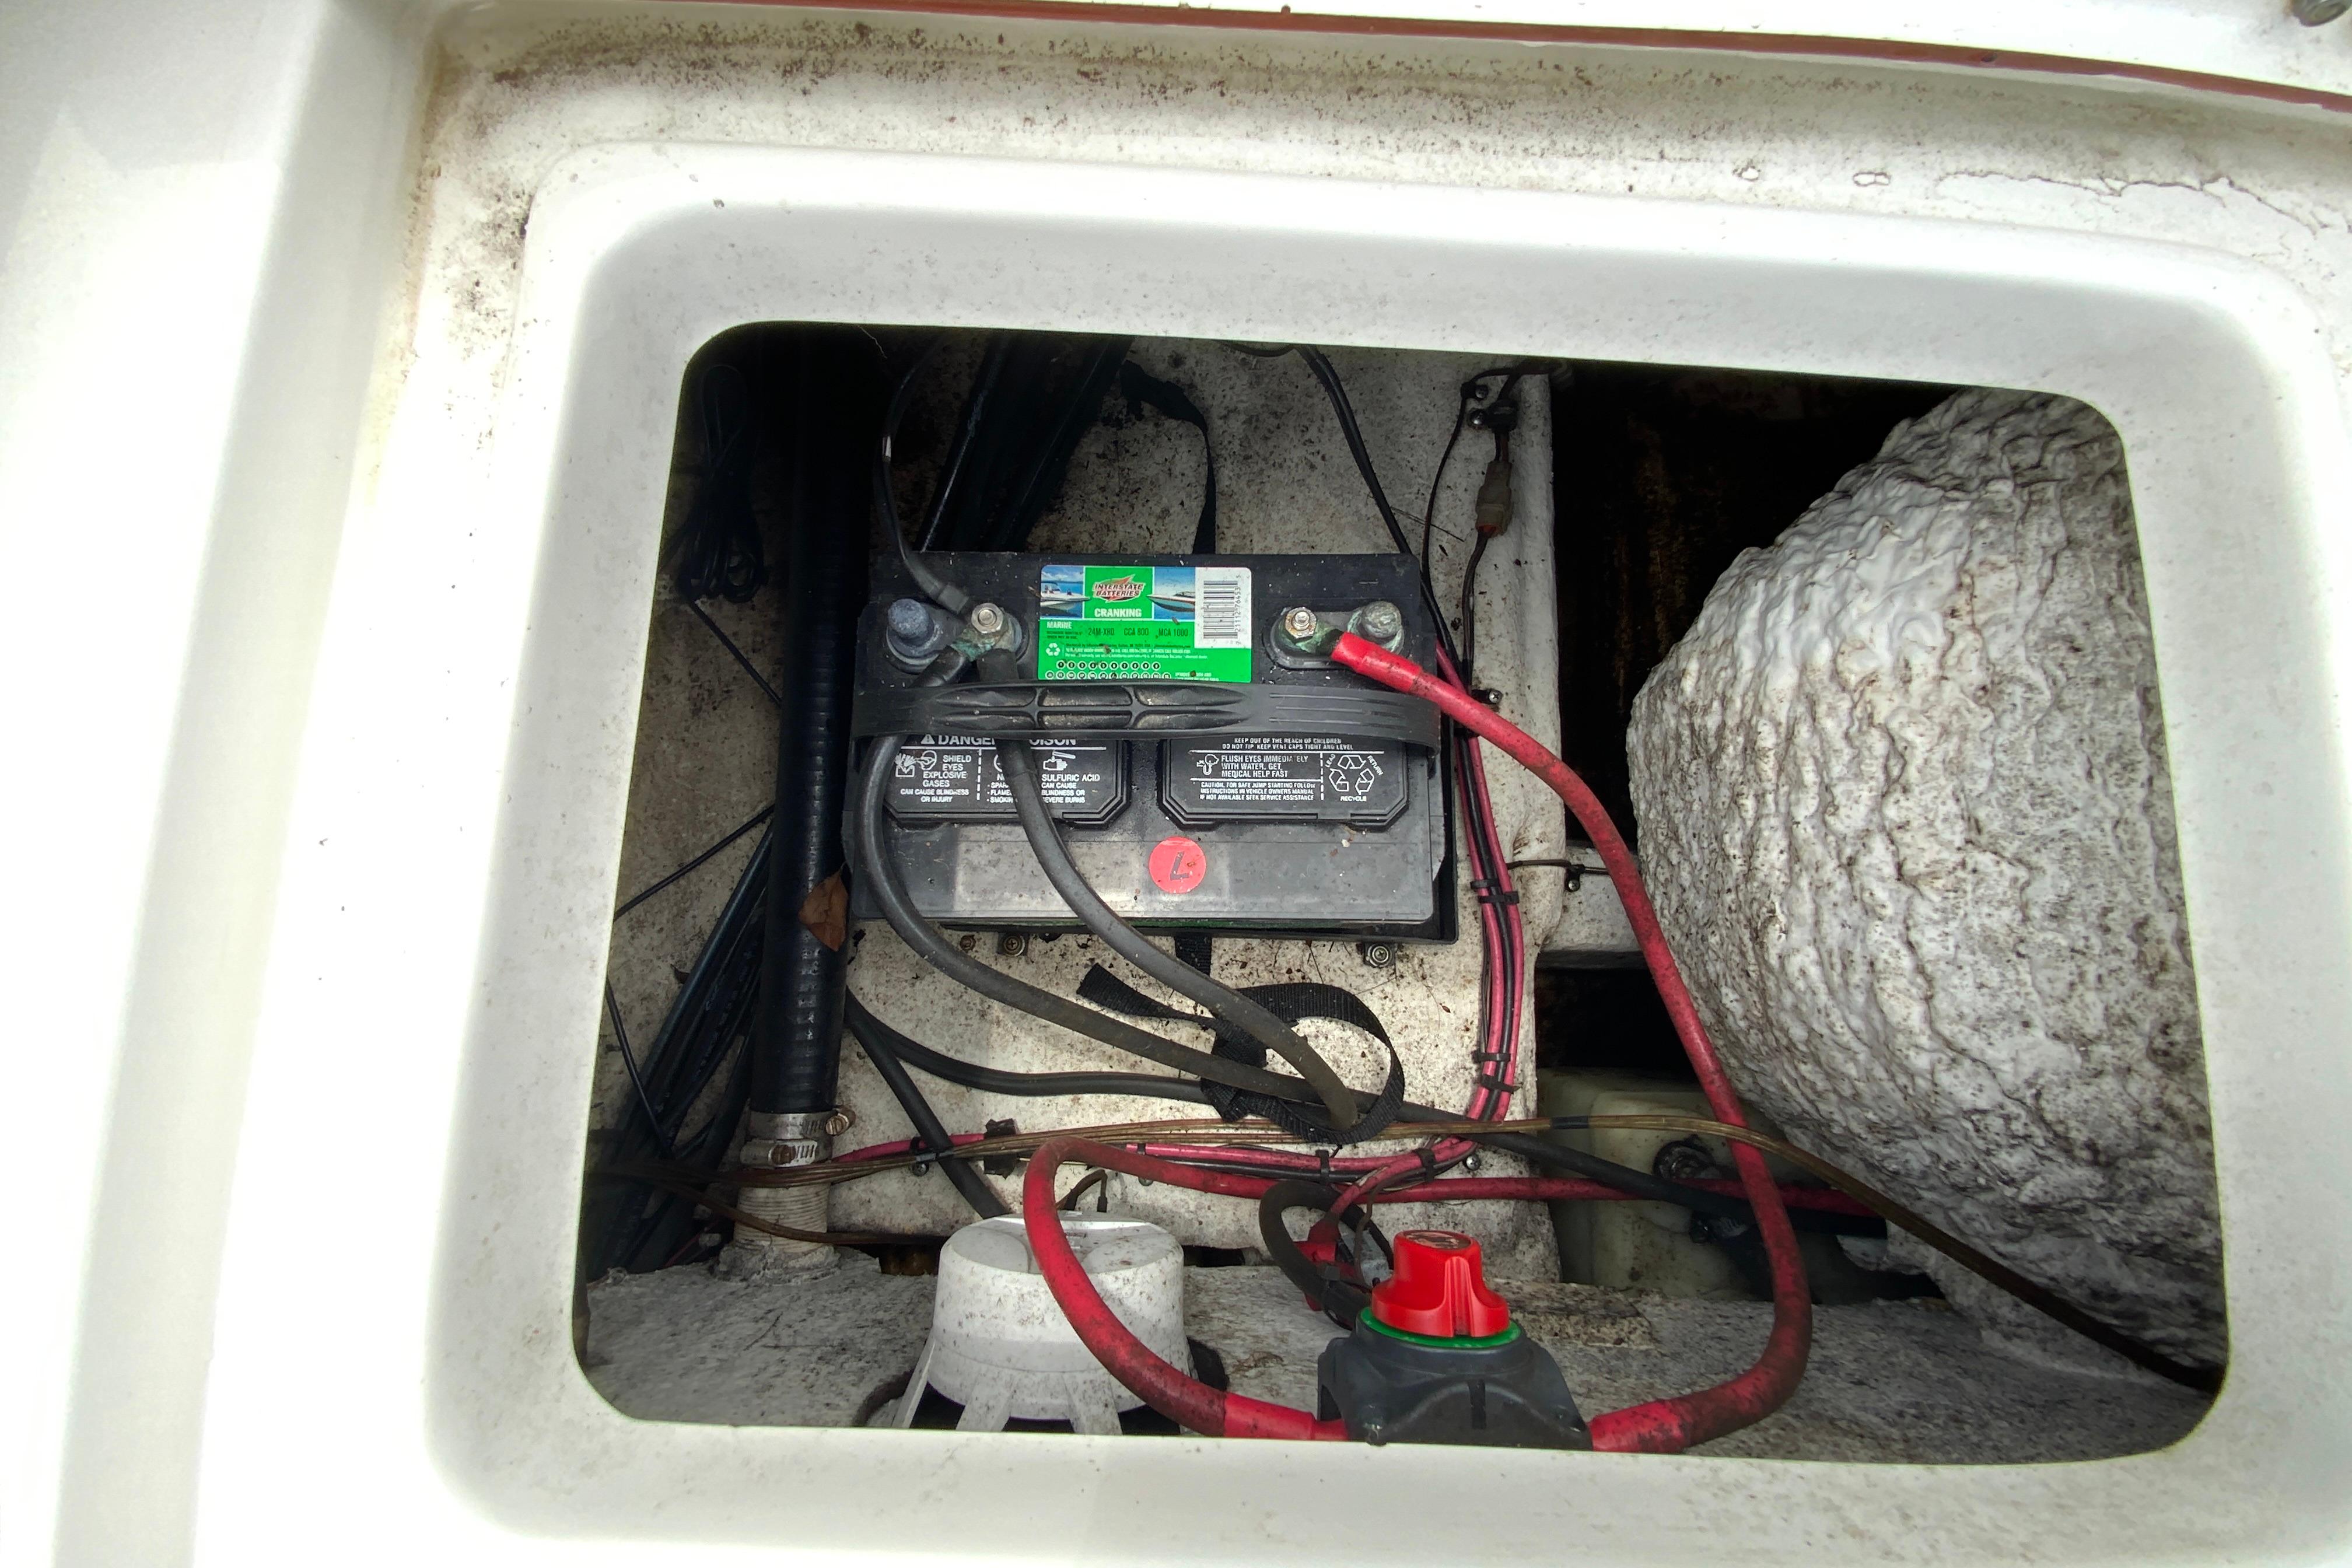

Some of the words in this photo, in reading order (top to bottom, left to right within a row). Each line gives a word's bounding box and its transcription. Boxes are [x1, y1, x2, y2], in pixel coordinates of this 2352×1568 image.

[1094, 608, 1142, 617] CRANKING
[1124, 628, 1136, 636] CCA
[1138, 628, 1149, 636] 800
[1158, 628, 1171, 636] MCA
[1174, 628, 1188, 637] 1000
[938, 736, 996, 745] DANGE
[1325, 754, 1336, 768] LEAD
[1367, 755, 1384, 776] RETURN
[1041, 774, 1079, 782] SULFURIC
[1082, 774, 1100, 782] ACID
[922, 779, 950, 788] GASES
